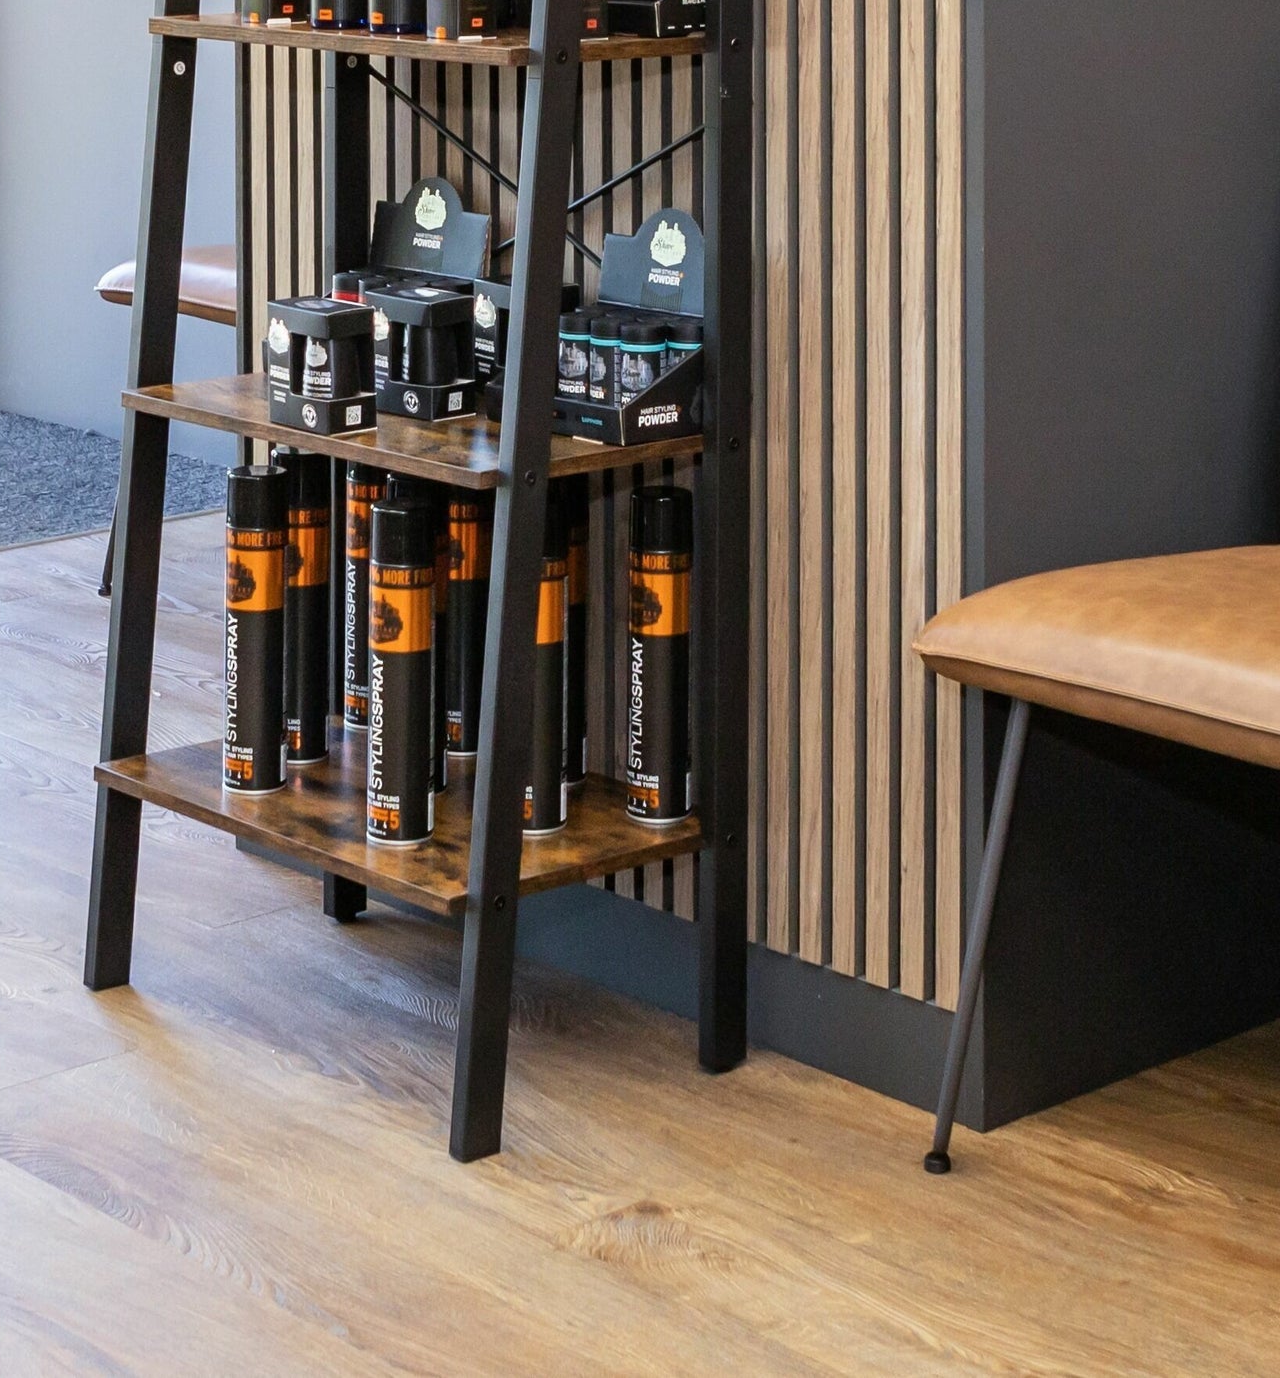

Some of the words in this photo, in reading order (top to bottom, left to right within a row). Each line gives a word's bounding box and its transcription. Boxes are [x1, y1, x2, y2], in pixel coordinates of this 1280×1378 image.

[412, 237, 441, 249] POWDER
[648, 273, 680, 286] POWDER
[640, 406, 654, 414] HAIR
[654, 404, 676, 414] STYLING
[638, 412, 678, 428] POWDER
[237, 531, 264, 547] MORE
[642, 553, 671, 570] MORE
[383, 569, 411, 584] MORE
[347, 560, 357, 681] STYLINGSPRAY
[226, 612, 239, 743] STYLINGSPRAY
[631, 637, 644, 770] STYLINGSPRAY
[371, 653, 385, 790] STYLINGSPRAY
[231, 746, 254, 755] STYLING
[237, 753, 254, 761] TYPES
[243, 761, 254, 780] 5
[636, 773, 659, 783] STYLING
[642, 782, 659, 790] TYPES
[376, 793, 400, 803] STYLING
[382, 802, 400, 810] TYPES
[649, 789, 660, 809] 5
[523, 800, 534, 820] 5
[389, 809, 400, 831] 5
